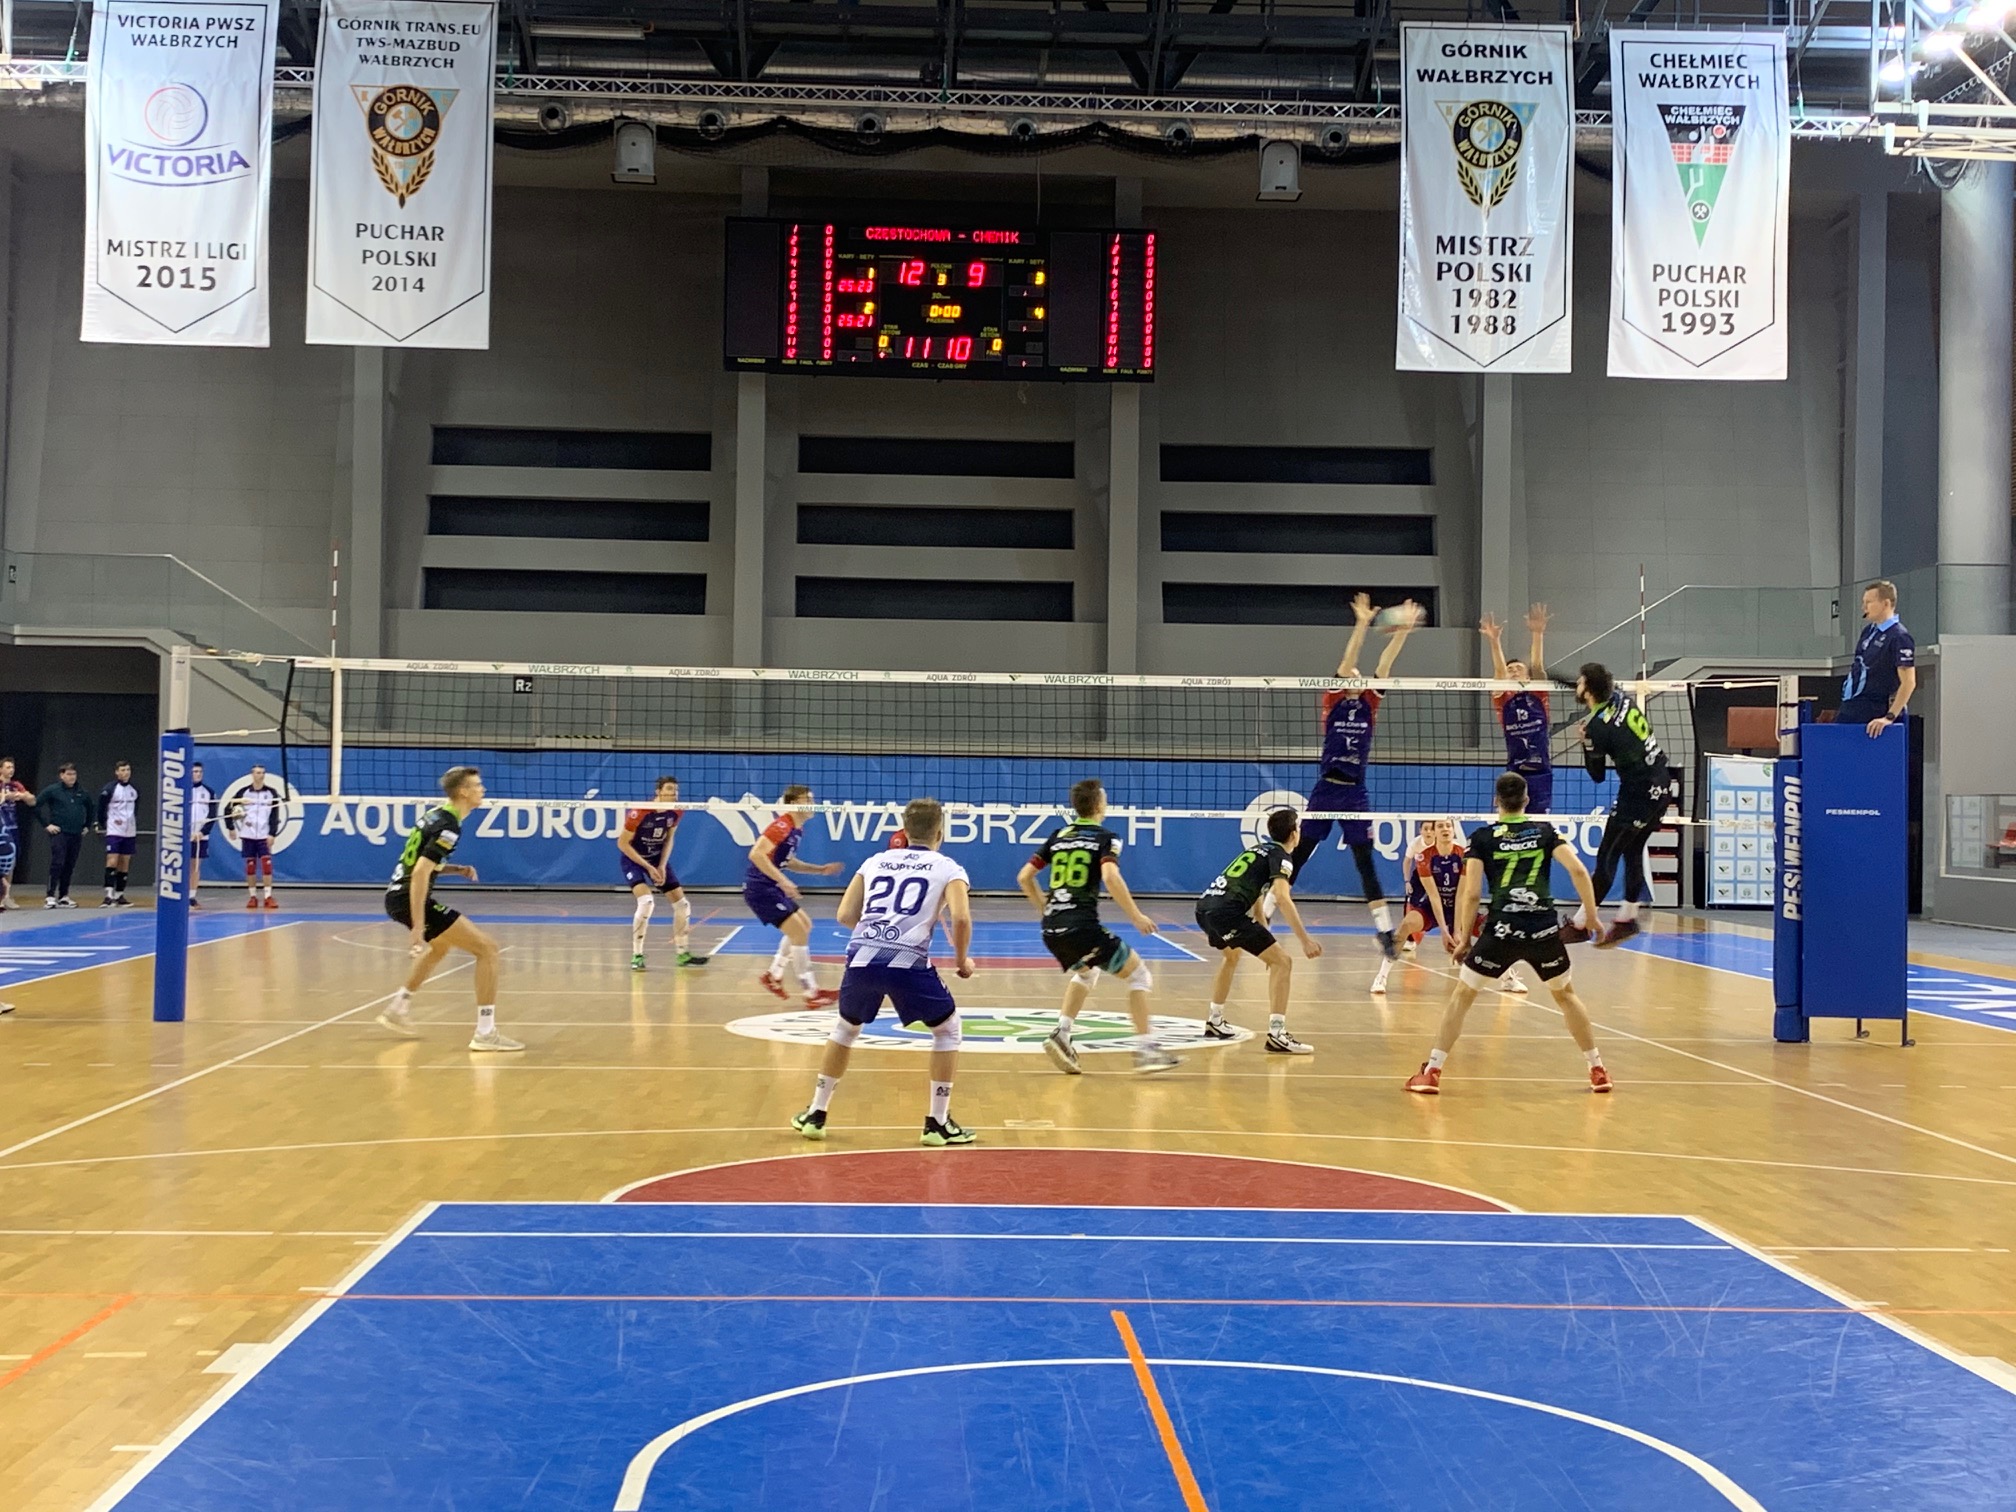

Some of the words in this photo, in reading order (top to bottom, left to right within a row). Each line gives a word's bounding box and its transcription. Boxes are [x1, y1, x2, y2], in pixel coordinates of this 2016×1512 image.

[118, 14, 200, 30] VICTORIA
[206, 17, 256, 31] PWSZ
[337, 16, 401, 32] GÓRNIK
[405, 20, 482, 37] TRANS.EU
[131, 34, 239, 48] WAŁBRZYCH
[355, 37, 461, 53] TWS-MAZBUD
[1441, 41, 1527, 60] GÓRNIK
[358, 54, 455, 69] WAŁBRZYCH
[1650, 53, 1748, 71] CHEŁMIEC
[1416, 68, 1554, 86] WAŁBRZYCH
[1638, 73, 1760, 91] WAŁBRZYCH
[1664, 114, 1740, 125] WAŁBRZYCH
[1670, 105, 1734, 116] CHEŁMIEC
[106, 143, 251, 178] VICTORIA
[355, 222, 444, 242] PUCHAR
[972, 230, 1020, 244] CHEMIK
[106, 239, 188, 259] MISTRZ
[193, 241, 200, 259] I
[206, 241, 247, 261] LIGI
[1435, 235, 1535, 257] MISTRZ
[362, 249, 437, 268] POLSKI
[136, 265, 217, 292] 2015
[900, 262, 924, 286] 12
[968, 262, 985, 287] 9
[1436, 261, 1532, 284] POLSKI
[1652, 264, 1747, 285] PUCHAR
[371, 275, 426, 294] 2014
[1451, 288, 1518, 310] 1982
[1658, 288, 1740, 309] POLSKI
[1450, 314, 1517, 337] 1988
[1662, 312, 1736, 336] 1993
[878, 334, 889, 348] 0
[992, 338, 1002, 352] 0
[405, 662, 430, 671] AQUA
[528, 664, 600, 675] WAŁBRZYCH
[668, 668, 692, 677] AQUA
[694, 668, 720, 678] ZDRÓJ
[788, 670, 859, 680] WAŁBRZYCH
[926, 672, 950, 682] AQUA
[952, 672, 977, 682] ZDRÓJ
[1044, 674, 1114, 684] WAŁBRZYCH
[1181, 677, 1204, 686] AQUA
[1299, 678, 1368, 688] WAŁBRZYCH
[1436, 680, 1458, 690] AQUA
[1460, 680, 1486, 690] ZDRÓJ
[320, 799, 427, 846] AQU
[475, 789, 624, 839] ZDRÓJ
[1825, 808, 1881, 816] PESMENPOL
[160, 747, 186, 900] PESMENPOL
[1050, 849, 1091, 889] 66
[1493, 848, 1545, 888] 77
[1444, 873, 1450, 886] 3
[864, 875, 929, 916] 20
